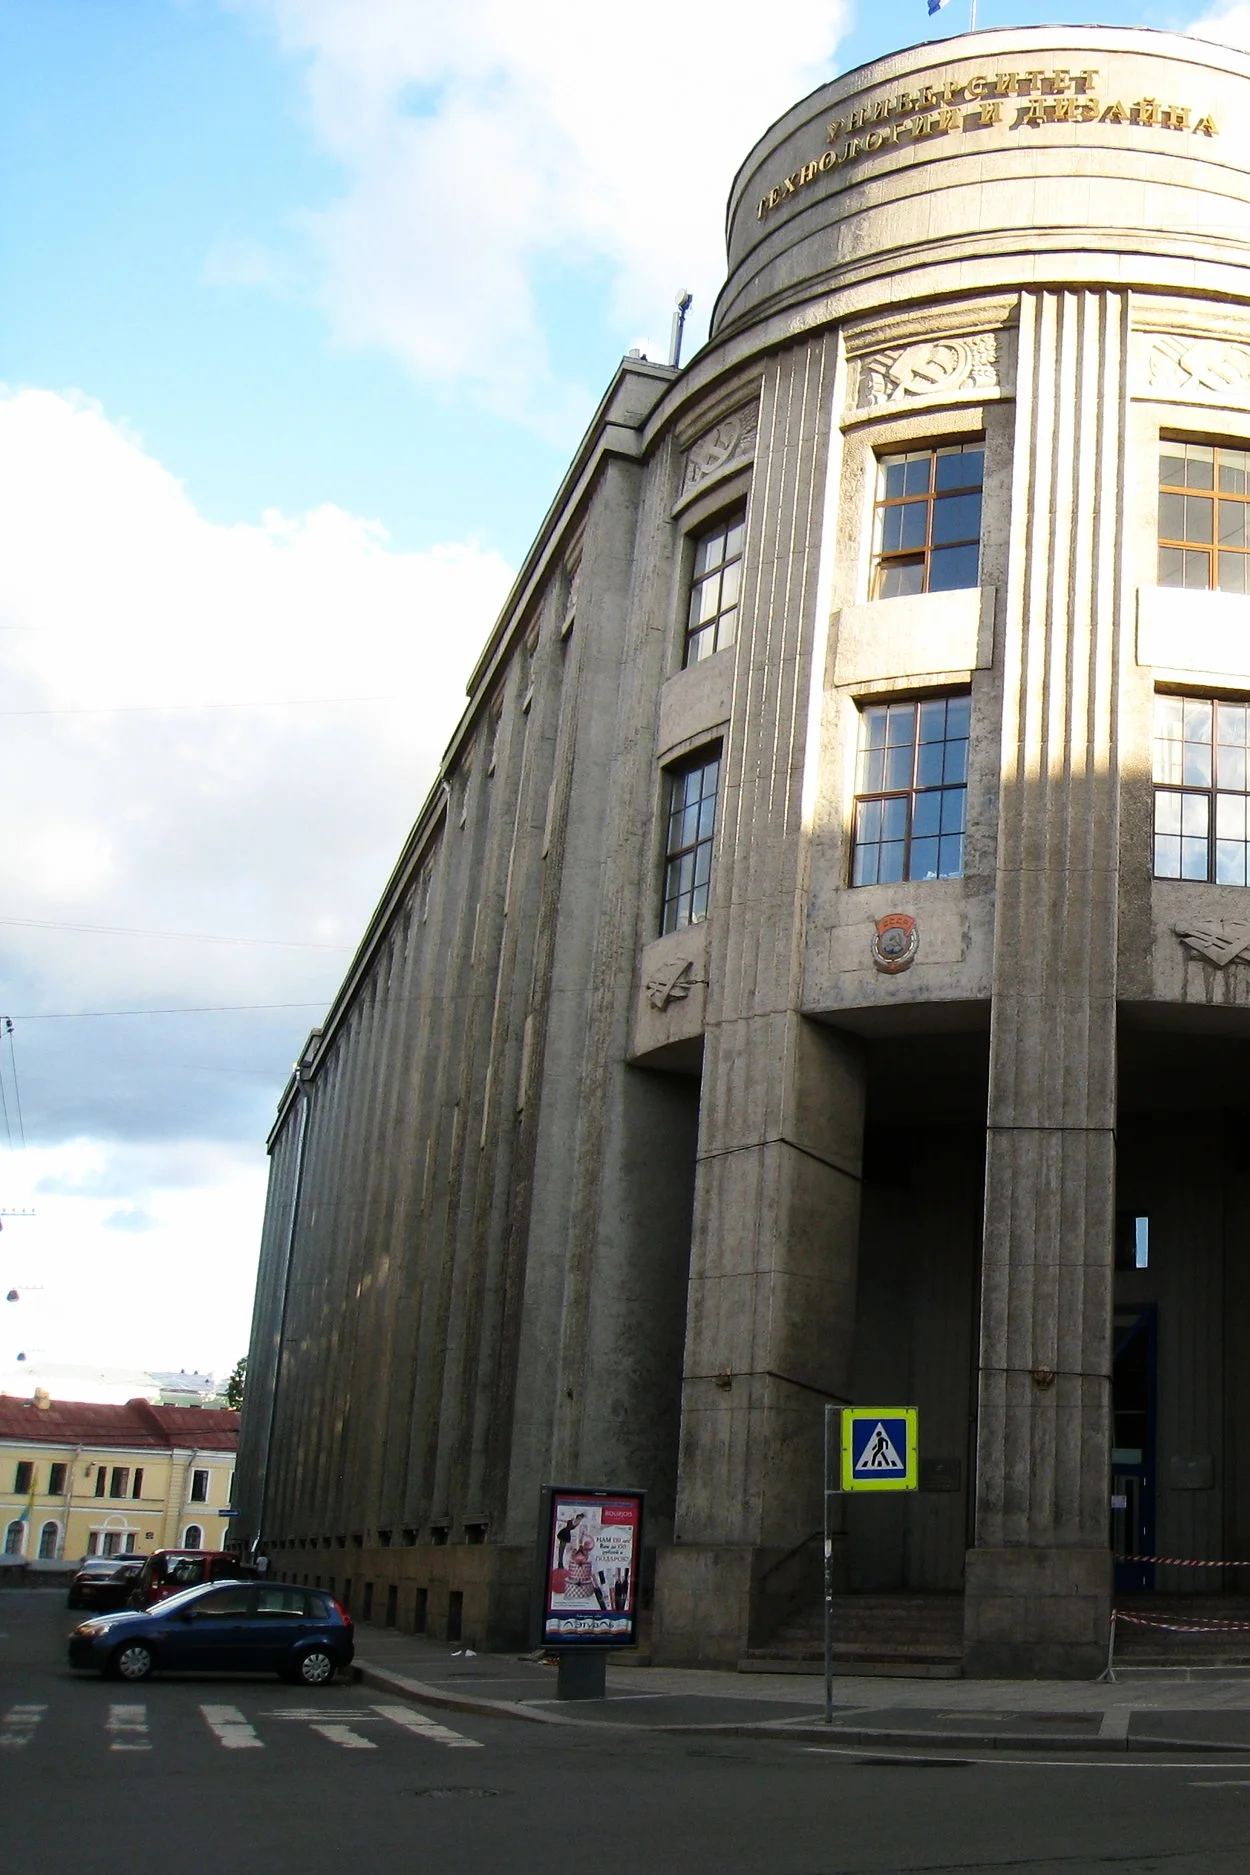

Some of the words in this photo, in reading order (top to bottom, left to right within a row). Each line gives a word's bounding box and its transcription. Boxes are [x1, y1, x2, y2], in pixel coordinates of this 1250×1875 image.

[826, 69, 1099, 143] УНИВЕРСИТЕТ
[756, 107, 961, 221] ТЕХНОЛОГИИ
[979, 101, 1004, 126] И
[1023, 96, 1220, 136] ДИЗАЙНА
